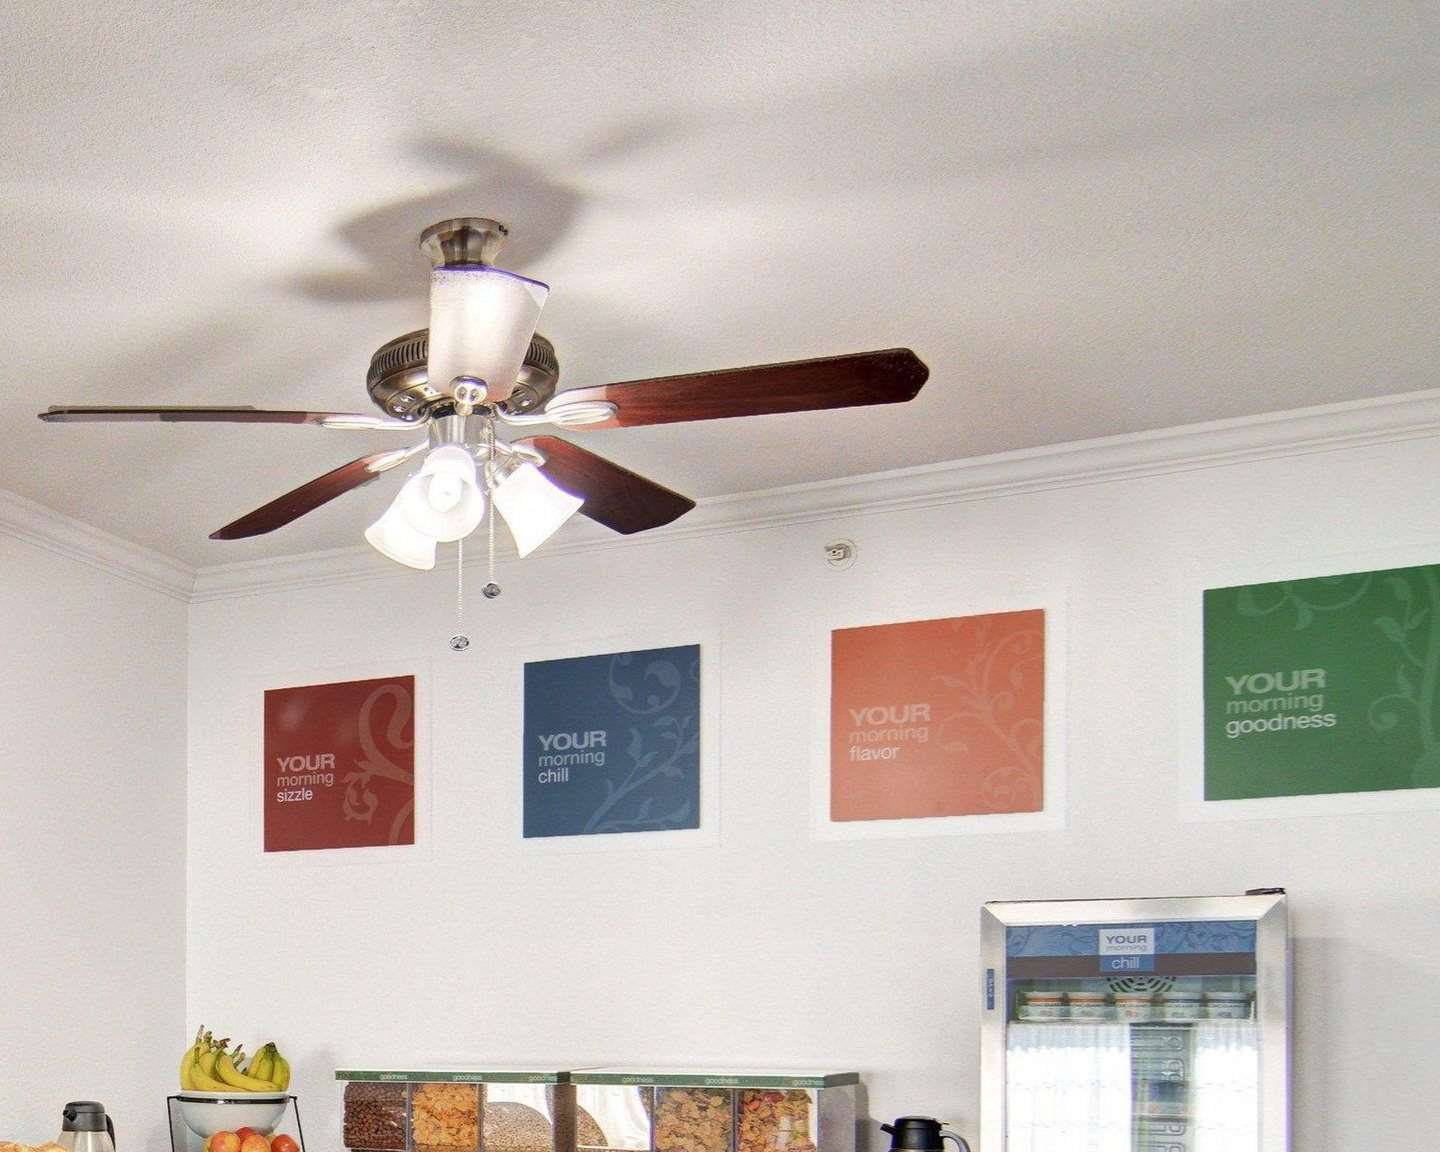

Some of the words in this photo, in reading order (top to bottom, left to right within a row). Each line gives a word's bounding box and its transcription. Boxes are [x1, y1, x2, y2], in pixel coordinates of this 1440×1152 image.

[1225, 668, 1328, 695] YOUR
[1226, 692, 1325, 714] morning
[848, 703, 931, 726] YOUR
[848, 726, 929, 743] morning
[1225, 713, 1337, 739] goodness
[538, 730, 607, 751] YOUR
[539, 749, 606, 767] morning
[848, 745, 901, 762] flavor
[276, 753, 336, 772] YOUR
[276, 771, 334, 787] morning
[538, 767, 569, 784] chill
[276, 787, 313, 802] sizzle
[1105, 934, 1148, 944] YOUR
[1111, 956, 1140, 969] chill
